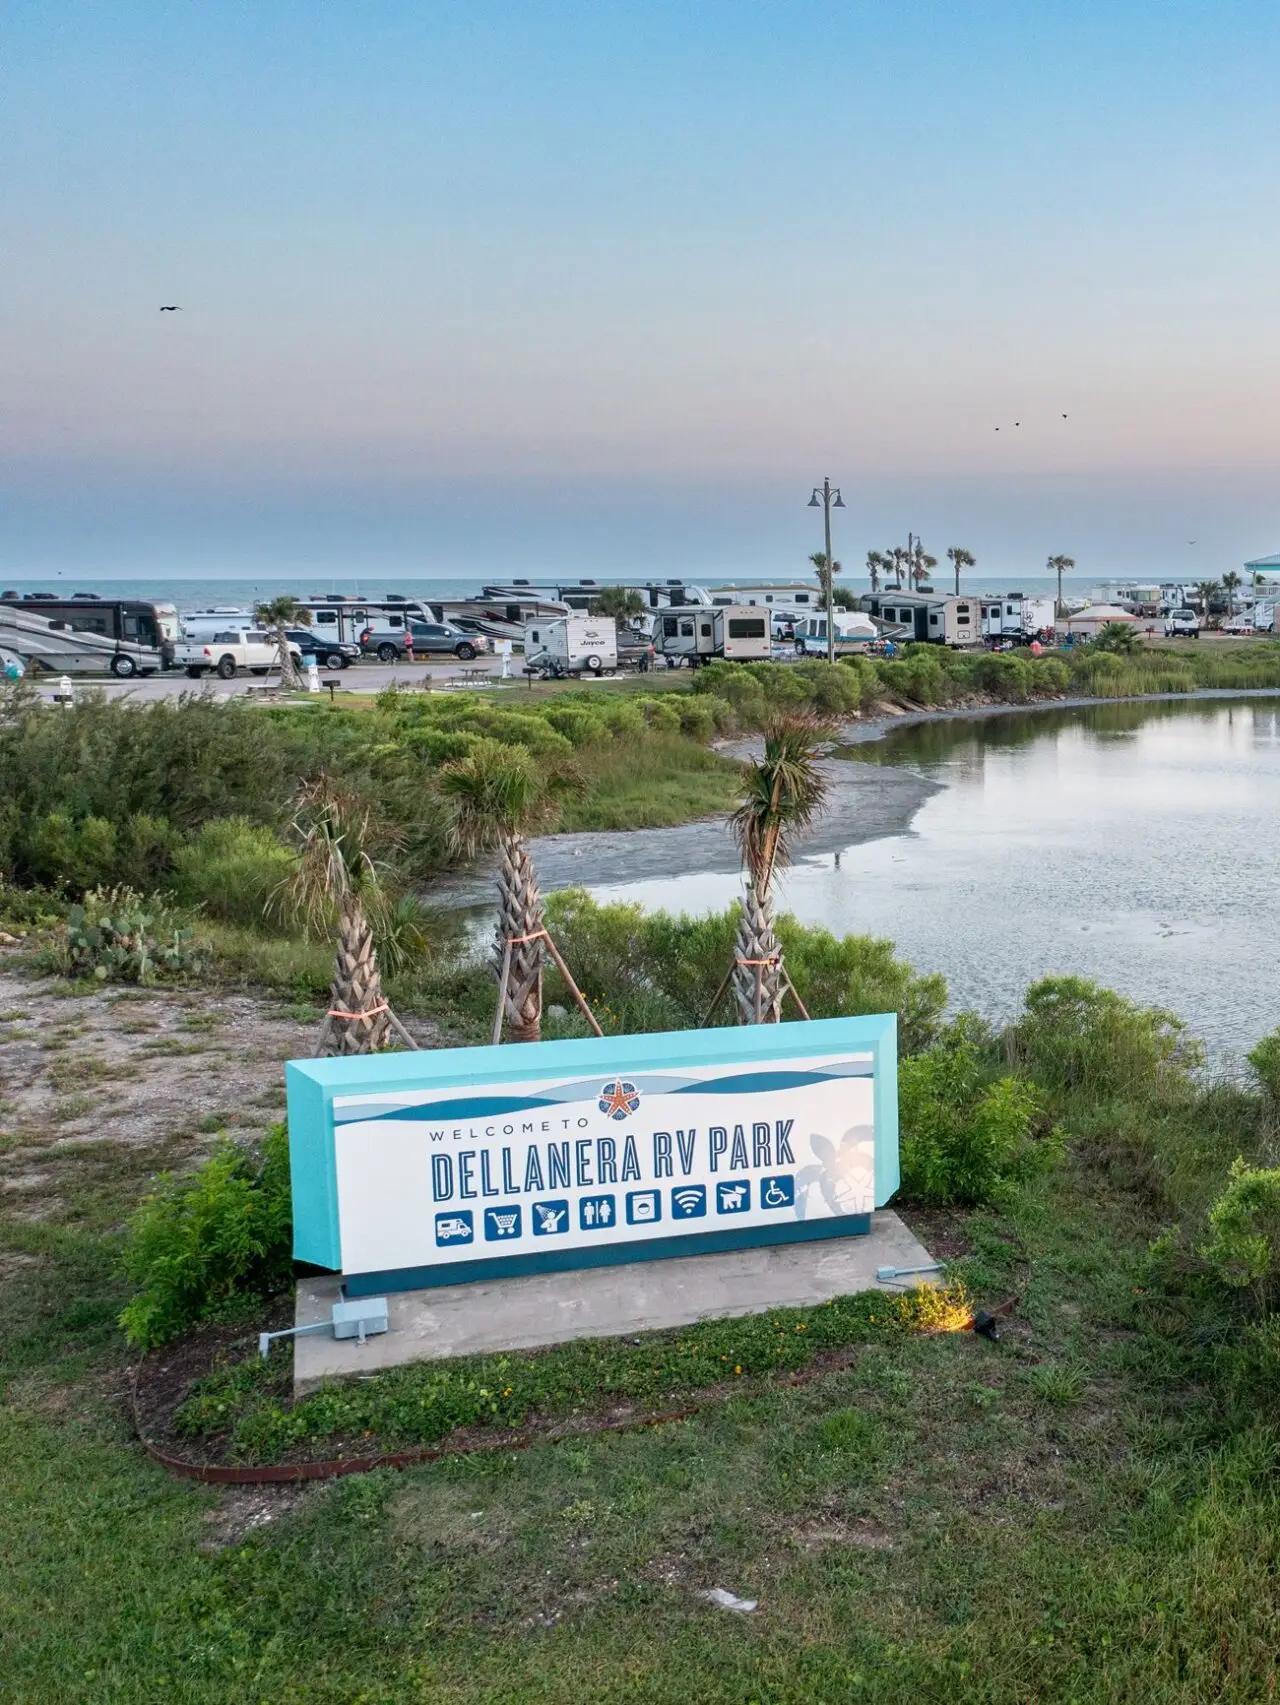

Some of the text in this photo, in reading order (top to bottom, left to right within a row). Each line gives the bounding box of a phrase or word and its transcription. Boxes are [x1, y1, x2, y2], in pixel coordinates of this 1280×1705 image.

[429, 1117, 589, 1142] WELCOME TO
[431, 1119, 796, 1203] DELLANERA RV PARK
